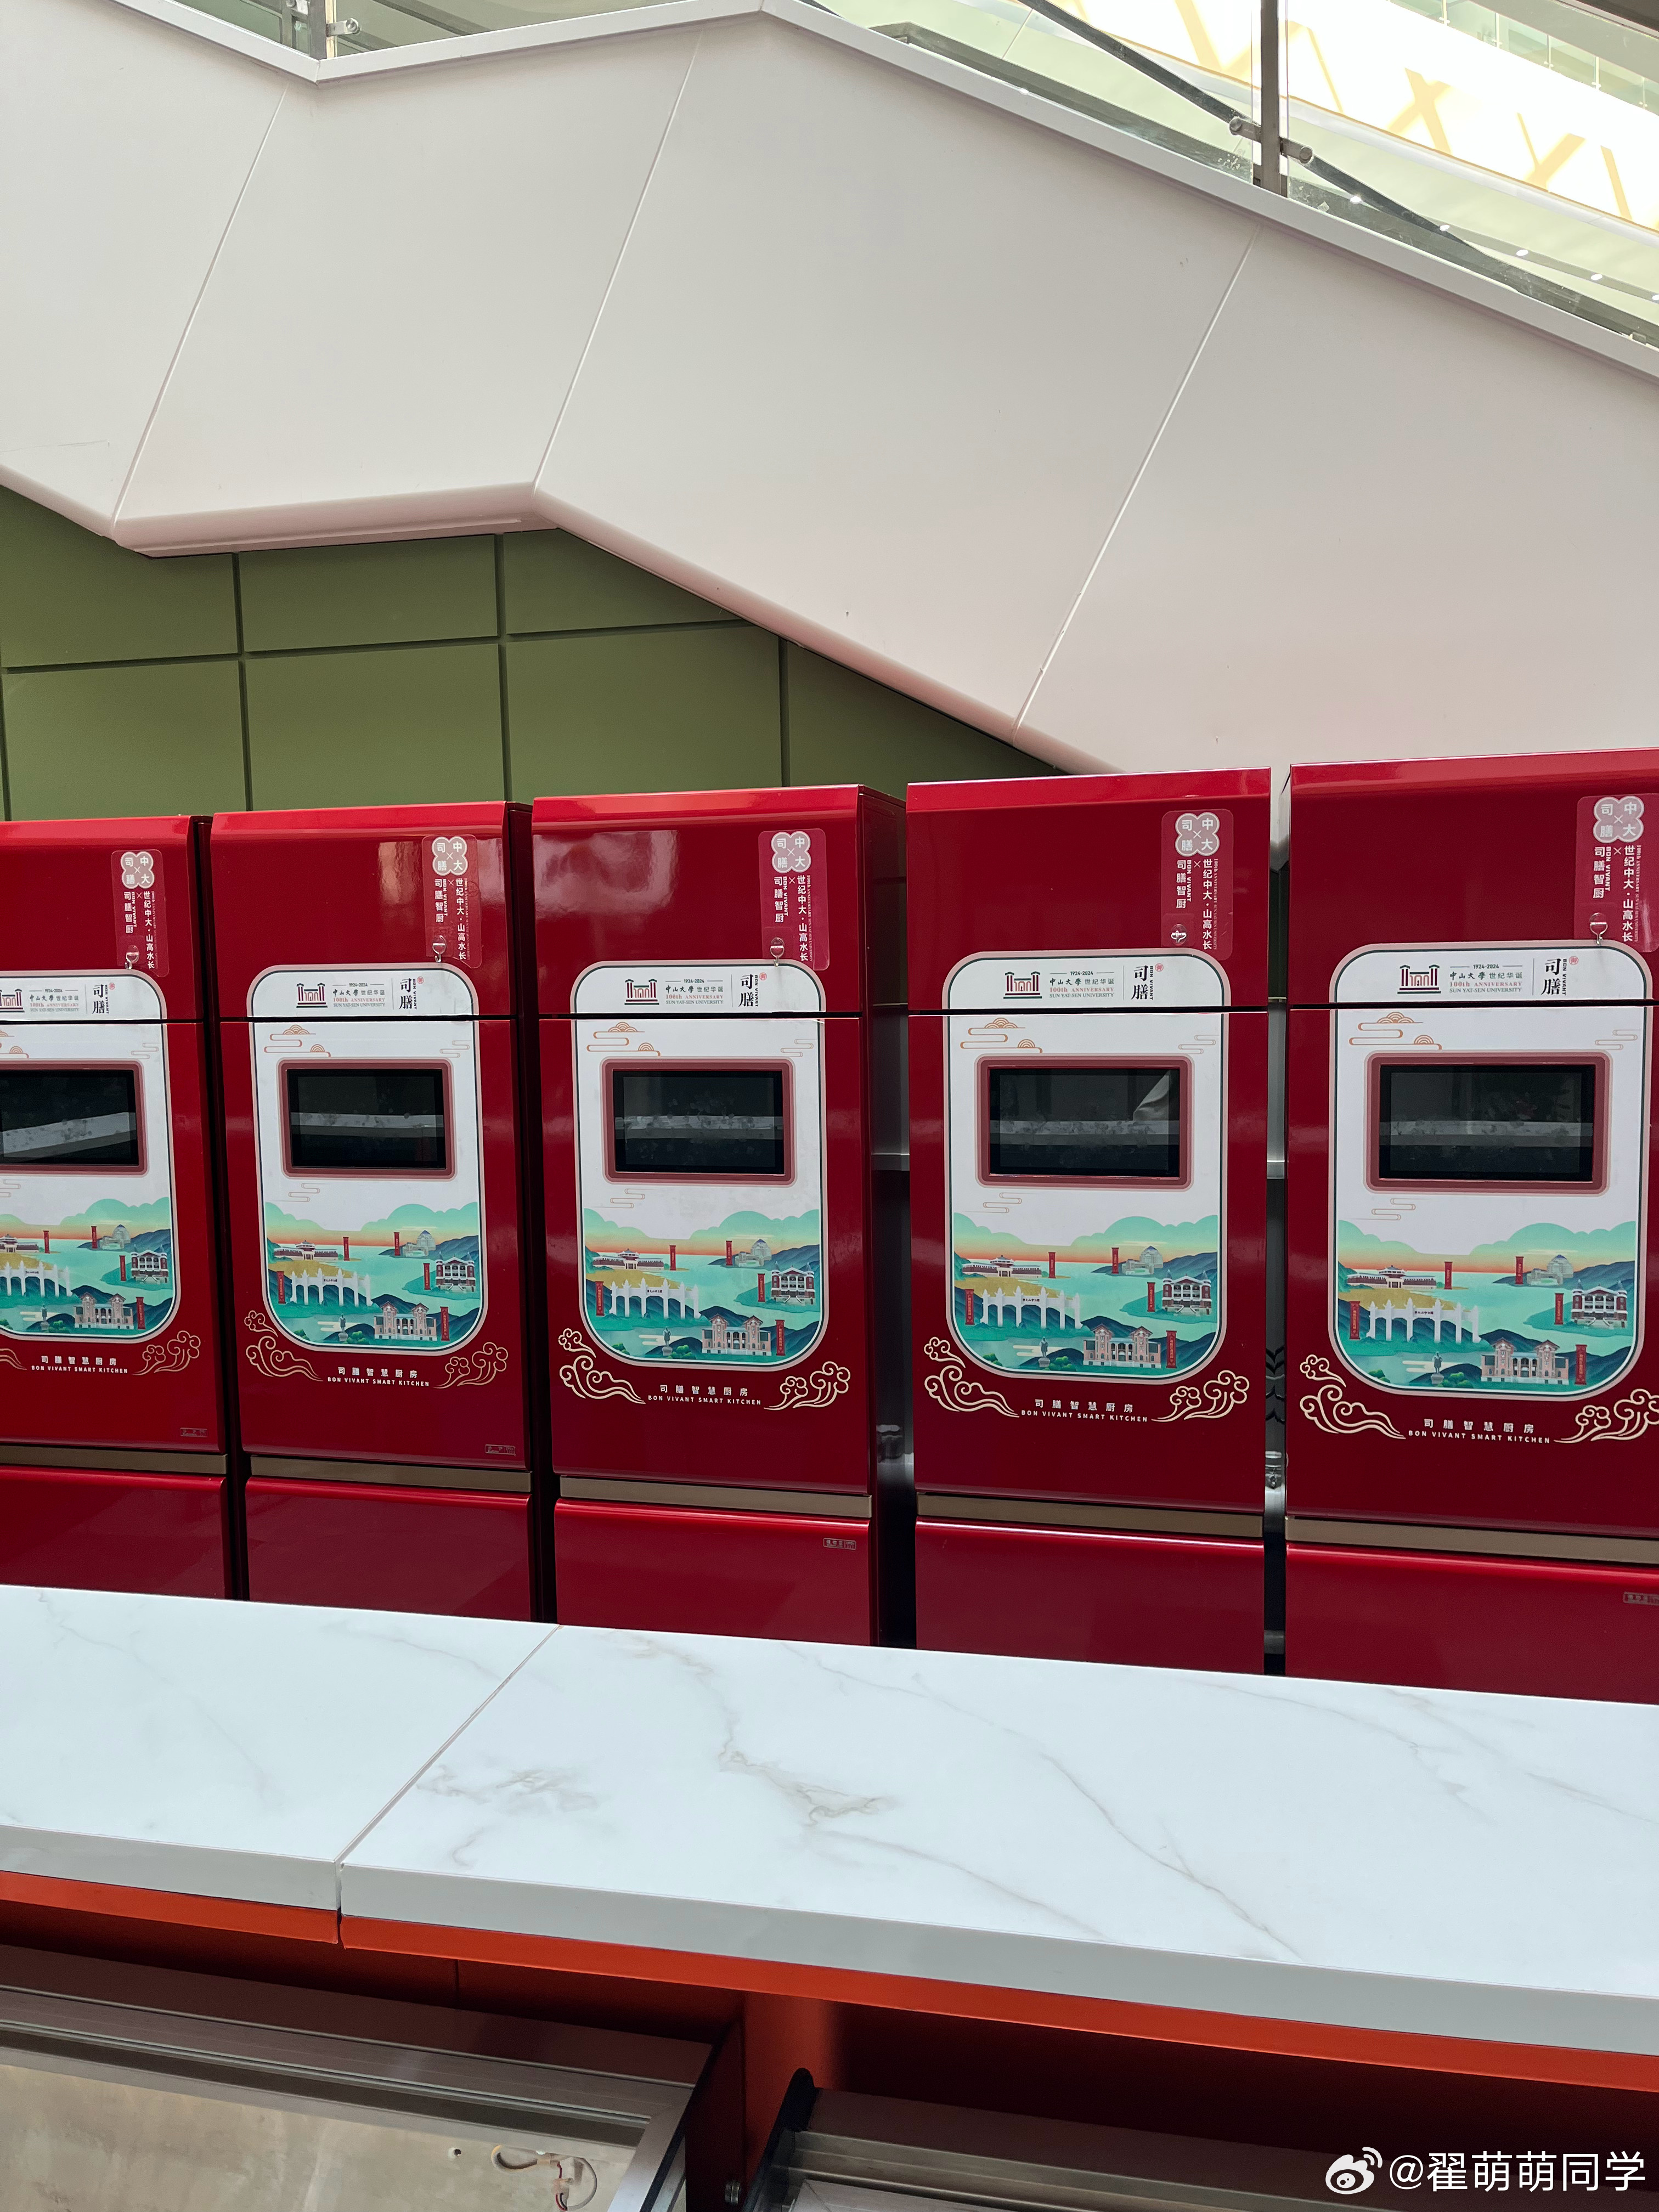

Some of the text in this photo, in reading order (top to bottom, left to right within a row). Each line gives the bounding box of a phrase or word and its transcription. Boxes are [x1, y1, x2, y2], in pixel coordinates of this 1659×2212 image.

[1201, 818, 1213, 850] 中大
[1600, 804, 1613, 837] 司膳
[1622, 802, 1637, 837] 中大
[1182, 820, 1193, 851] 司膳
[453, 841, 463, 871] 中大
[777, 838, 788, 868] 司膳
[795, 836, 805, 867] 中大
[140, 856, 150, 884] 中大
[1176, 860, 1186, 909] 司膳智厨
[1593, 847, 1605, 898] 司膳智厨
[774, 876, 784, 922] 司膳智厨
[738, 974, 754, 1007] 司膳
[1131, 965, 1148, 1000] 司膳
[1541, 958, 1561, 995] 司膳
[399, 978, 413, 1009] 司膳
[660, 1385, 748, 1396] 司膳智慧厨房
[1035, 1399, 1133, 1413] 司膳智慧厨房
[1424, 1419, 1533, 1434] 司膳智慧厨房
